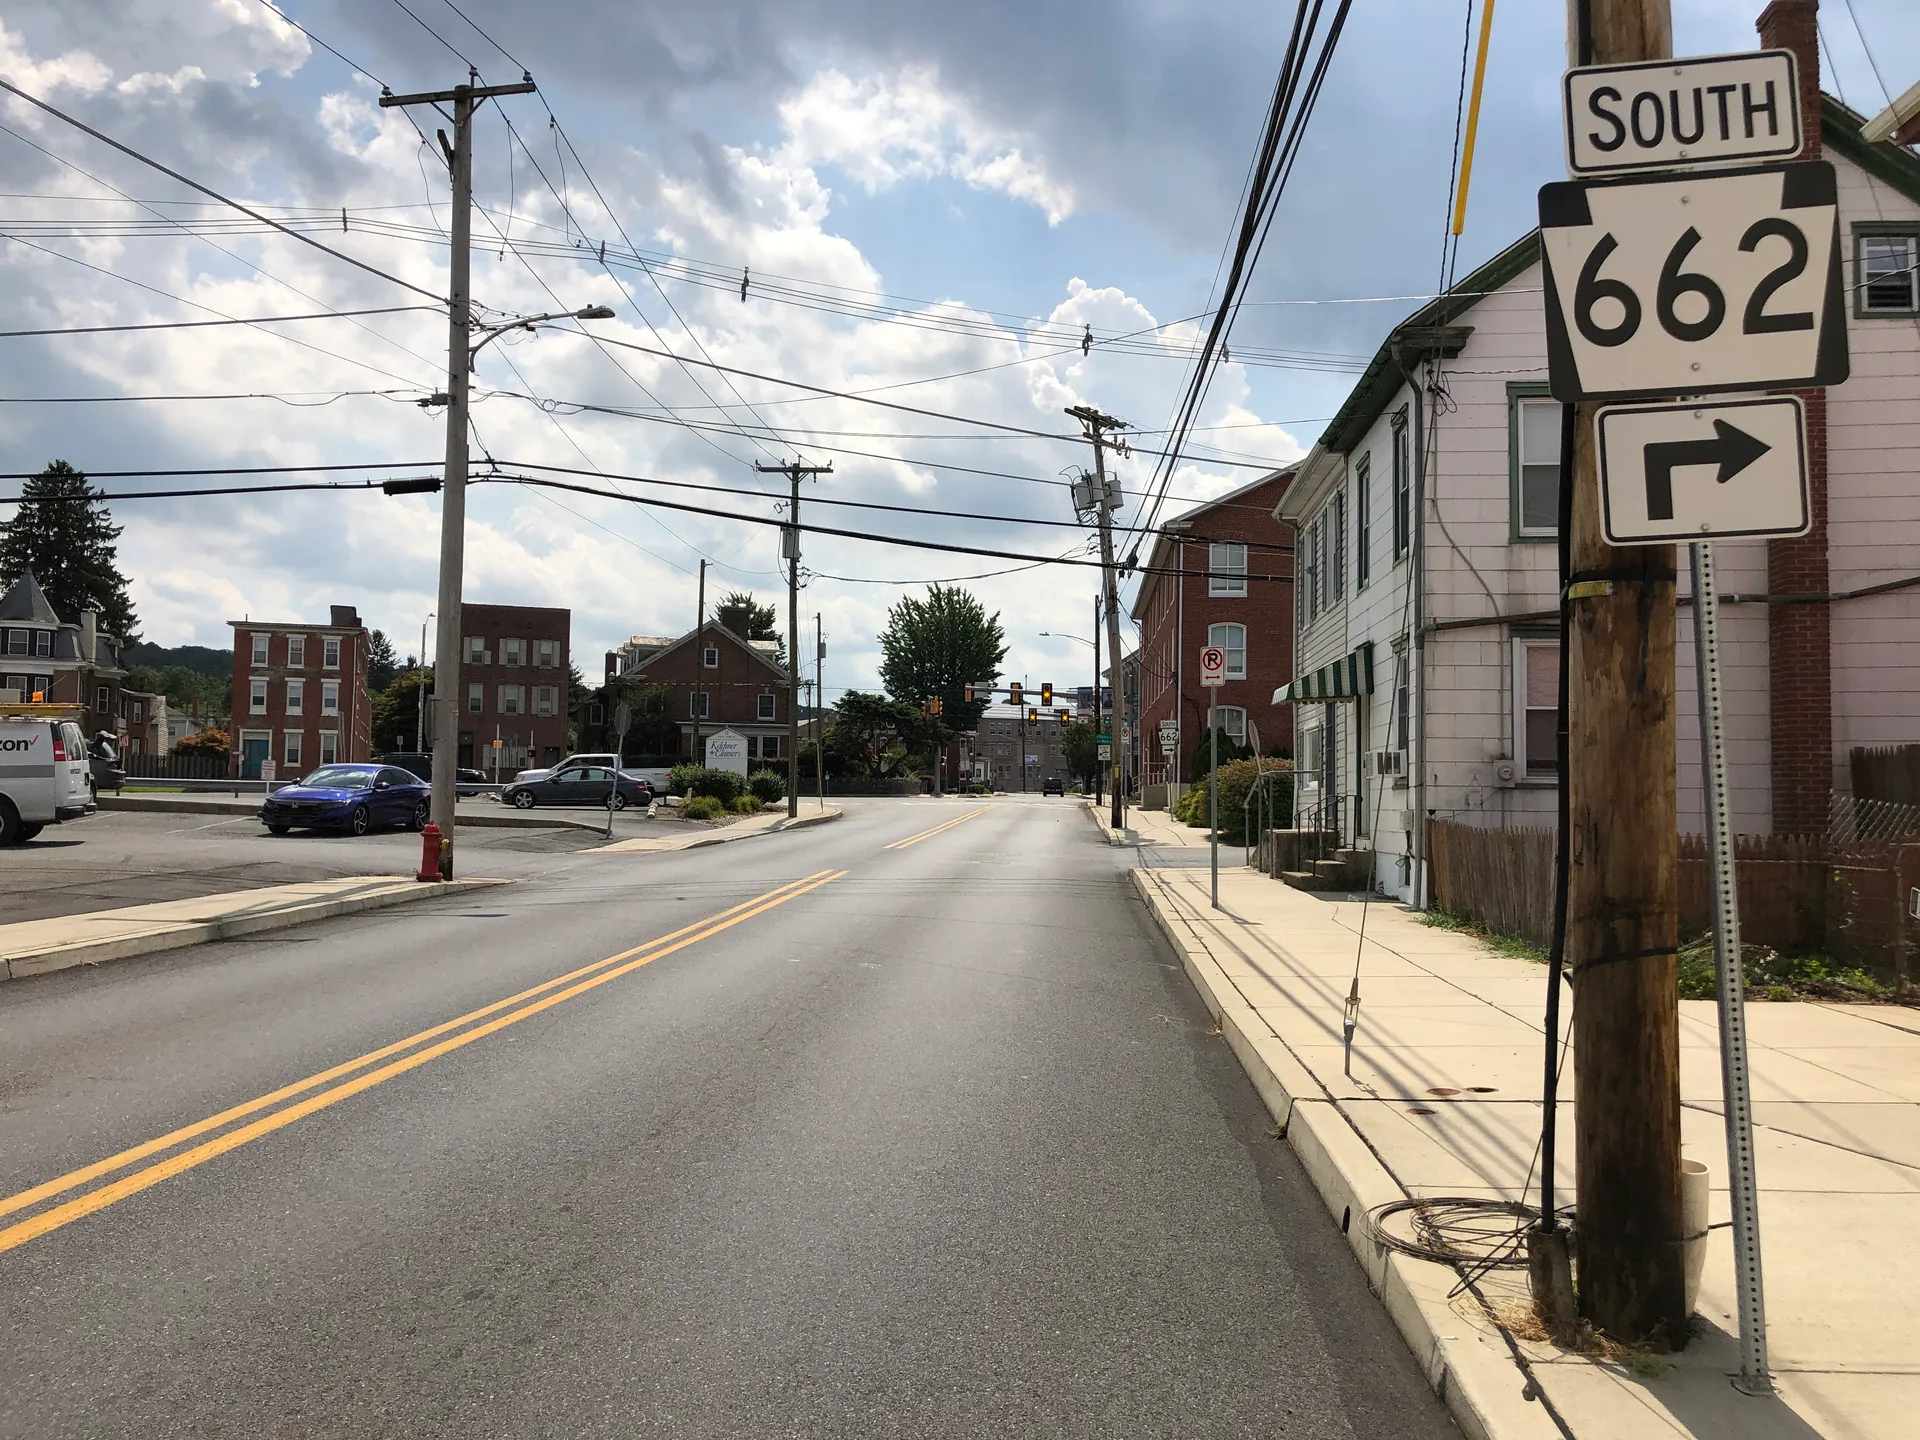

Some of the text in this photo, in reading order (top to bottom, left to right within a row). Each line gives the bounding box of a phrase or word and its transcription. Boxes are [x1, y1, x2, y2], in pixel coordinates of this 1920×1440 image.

[1588, 80, 1778, 152] SOUTH
[1574, 217, 1815, 348] 662
[715, 749, 741, 757] Cleaners
[1160, 732, 1177, 741] 662
